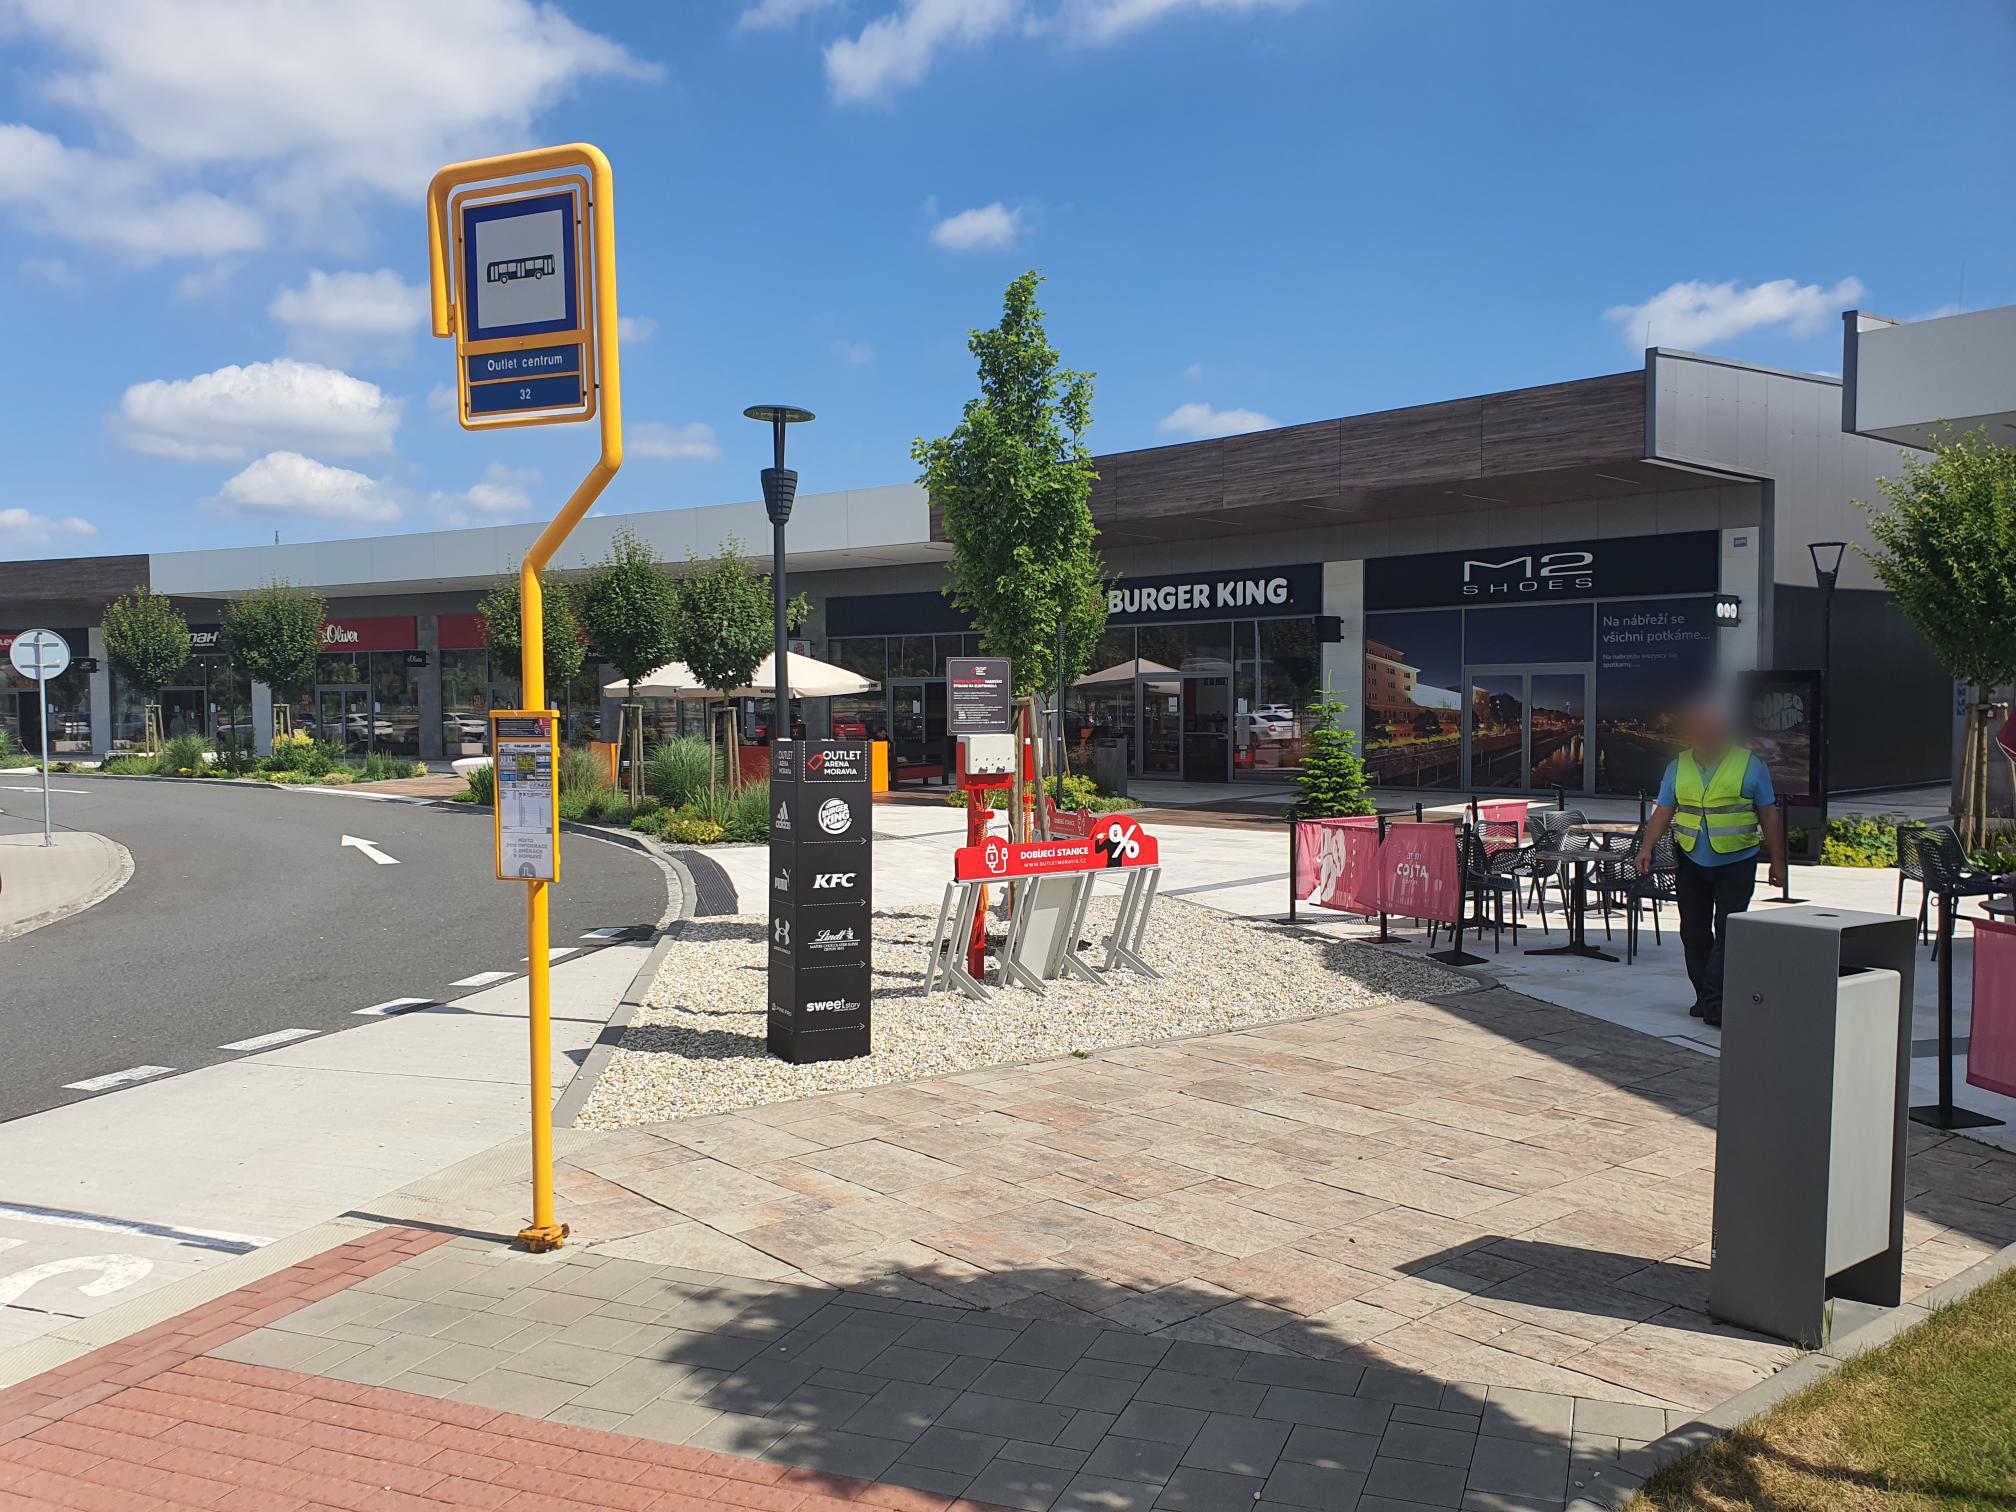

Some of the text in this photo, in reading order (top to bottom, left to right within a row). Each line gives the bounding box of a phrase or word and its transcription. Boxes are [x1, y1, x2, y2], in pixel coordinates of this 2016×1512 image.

[487, 355, 563, 371] Outlet centrum
[519, 388, 531, 400] 32
[1463, 551, 1594, 582] M2
[1463, 577, 1593, 595] SHOES
[1108, 577, 1288, 614] BURGER KING
[1603, 612, 1685, 627] Na nábřeží se
[1603, 630, 1644, 643] všichni
[778, 750, 793, 760] OUTLET
[822, 750, 862, 760] OUTLET
[824, 760, 849, 768] ARENA
[822, 803, 849, 818] BURGER
[775, 820, 791, 830] adidas
[823, 810, 850, 827] KING
[1020, 846, 1089, 860] DOBÍJECÍ STANICE
[1396, 862, 1428, 879] COSTA
[812, 872, 857, 889] KFC
[815, 929, 847, 942] Lindt
[806, 997, 846, 1012] sweet
